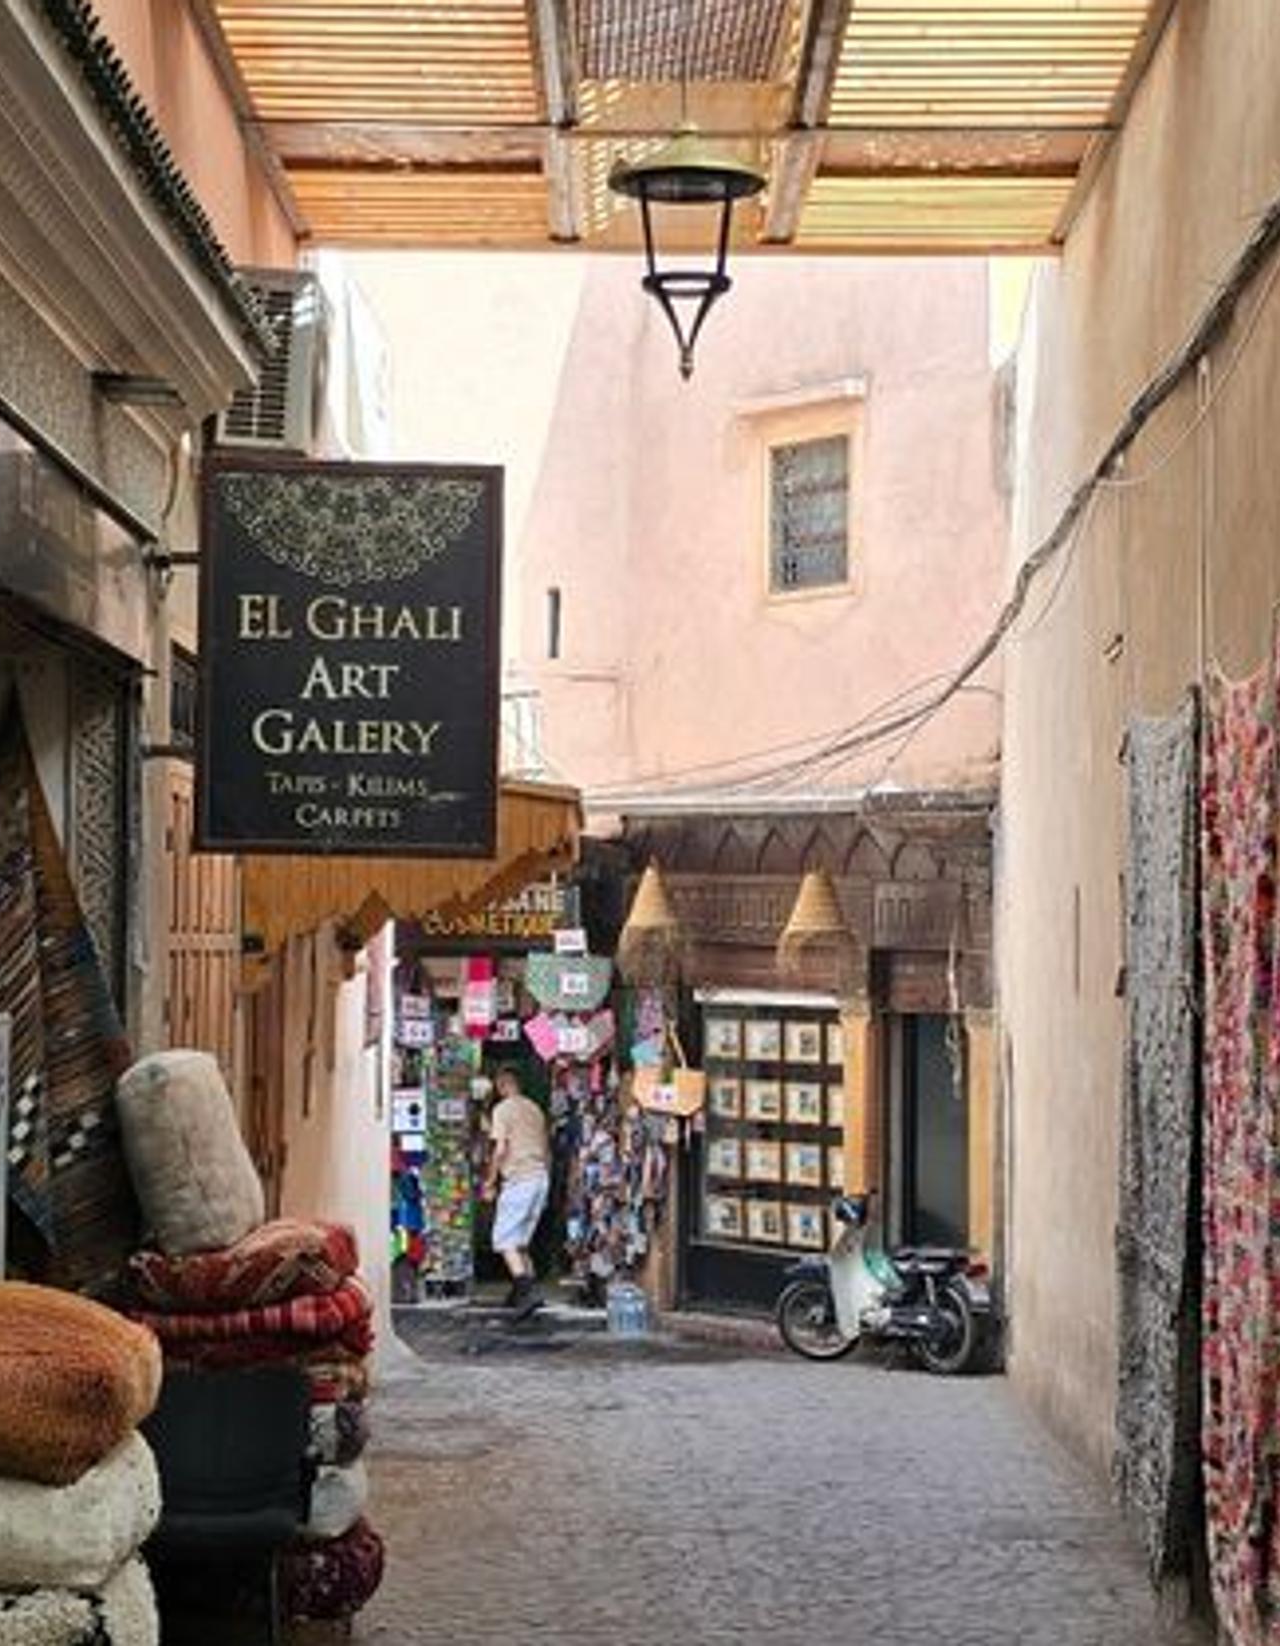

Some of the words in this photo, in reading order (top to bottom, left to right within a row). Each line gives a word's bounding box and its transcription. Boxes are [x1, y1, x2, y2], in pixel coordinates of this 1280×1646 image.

[237, 594, 293, 640] EL
[306, 594, 463, 641] GHALI
[299, 655, 401, 700] ART
[251, 708, 443, 756] GALERY
[294, 802, 402, 829] CARPETS
